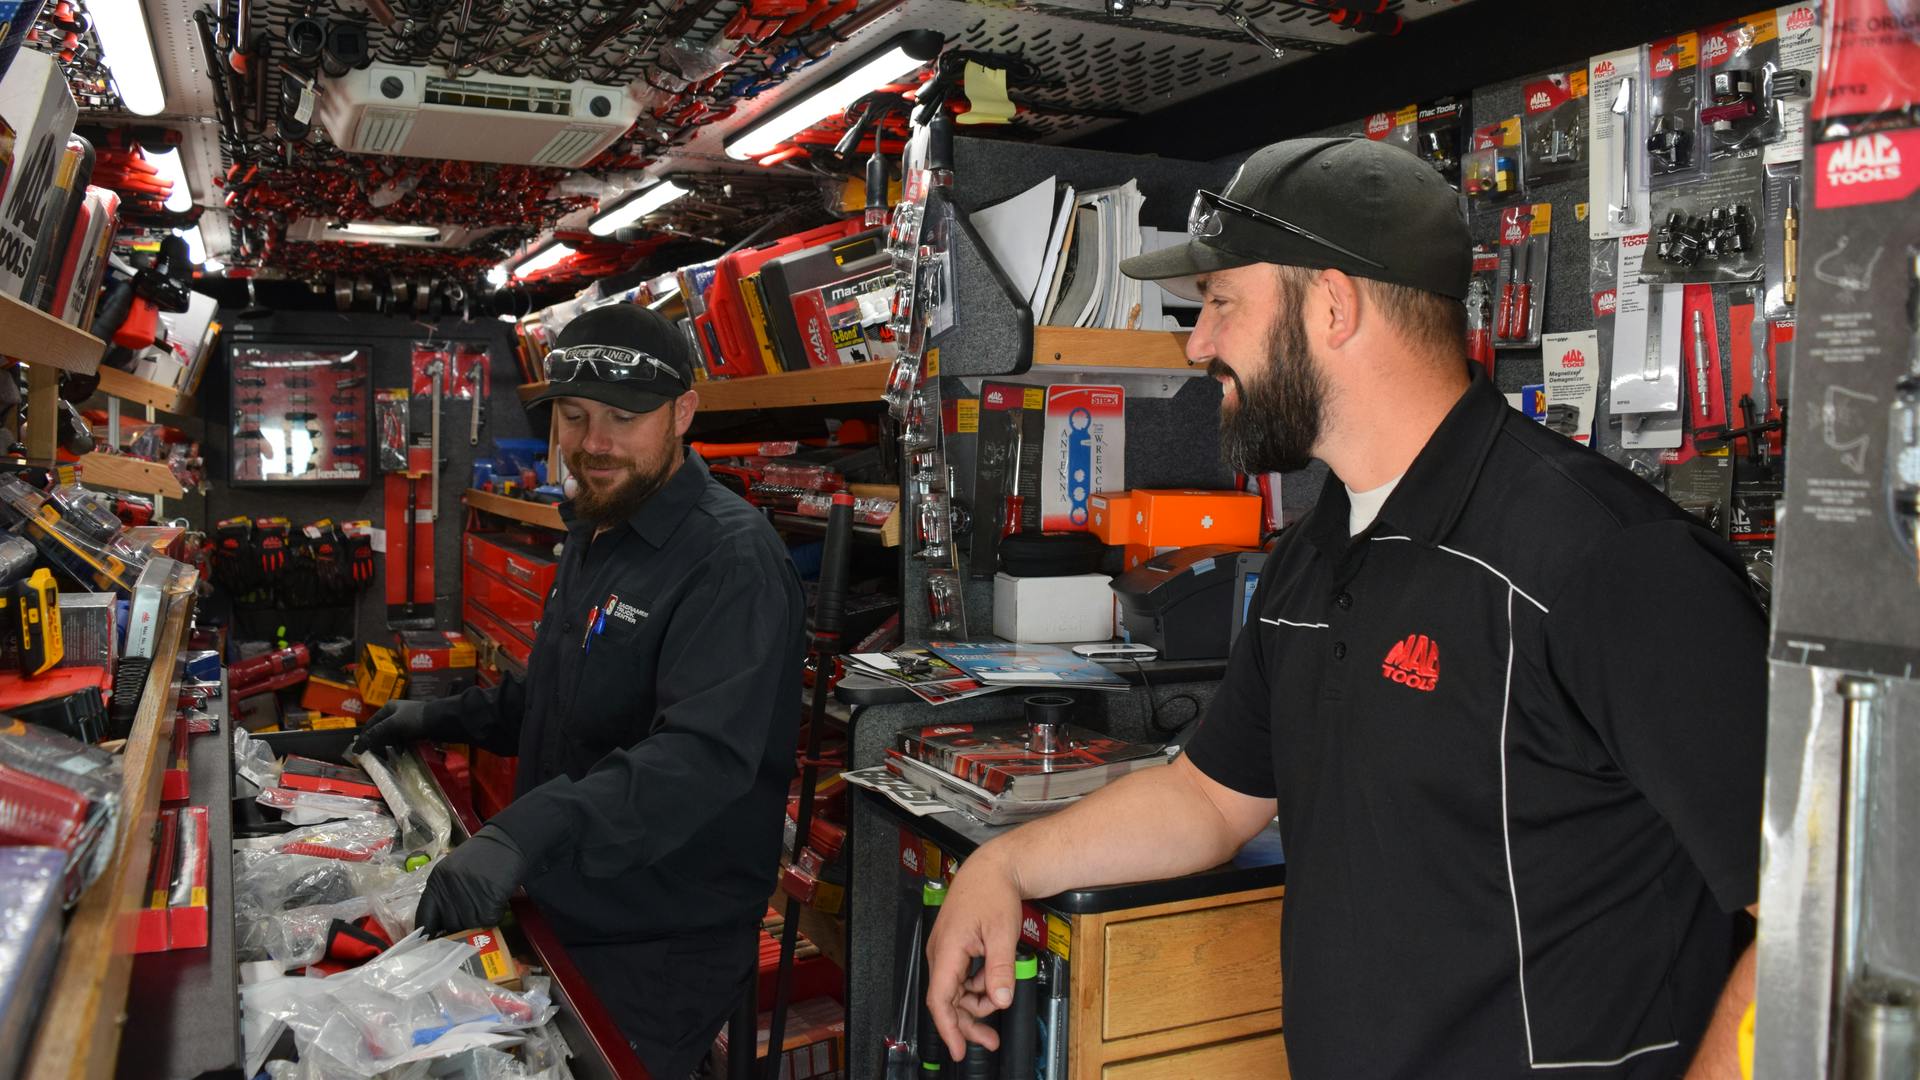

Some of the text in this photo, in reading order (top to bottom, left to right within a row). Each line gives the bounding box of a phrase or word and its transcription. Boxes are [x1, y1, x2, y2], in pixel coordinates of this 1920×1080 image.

[1419, 103, 1456, 119] Mac Tools
[1827, 133, 1901, 172] MAC
[1827, 164, 1901, 187] TOOLS
[832, 285, 858, 301] Mac
[832, 325, 858, 343] Q-Bond
[1562, 349, 1585, 364] MAC
[1095, 434, 1103, 494] WRENCH
[1384, 634, 1439, 677] MAC
[1382, 664, 1439, 691] TOOLS
